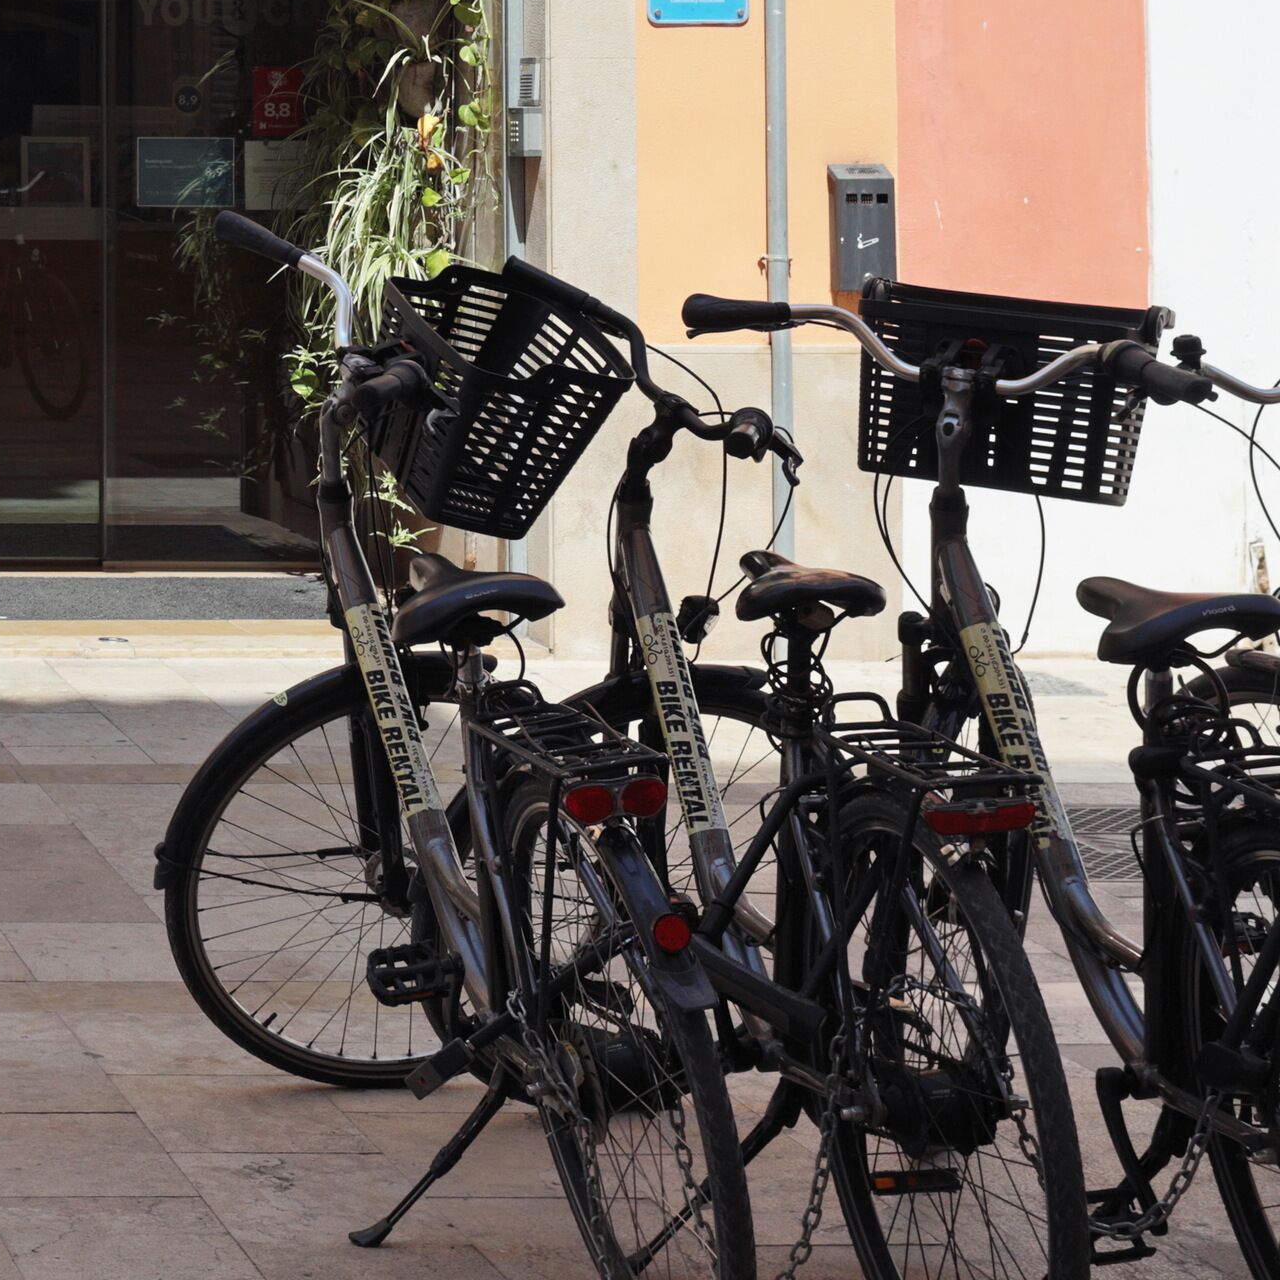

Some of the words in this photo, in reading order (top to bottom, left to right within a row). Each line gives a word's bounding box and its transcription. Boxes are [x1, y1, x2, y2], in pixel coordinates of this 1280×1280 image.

[177, 93, 198, 106] 8,9
[264, 102, 291, 120] 8,8
[365, 669, 397, 721] BIKE
[655, 680, 687, 733] BIKE
[985, 692, 1025, 747] BIKE
[380, 726, 424, 812] RENTAL
[670, 740, 709, 829] RENTAL
